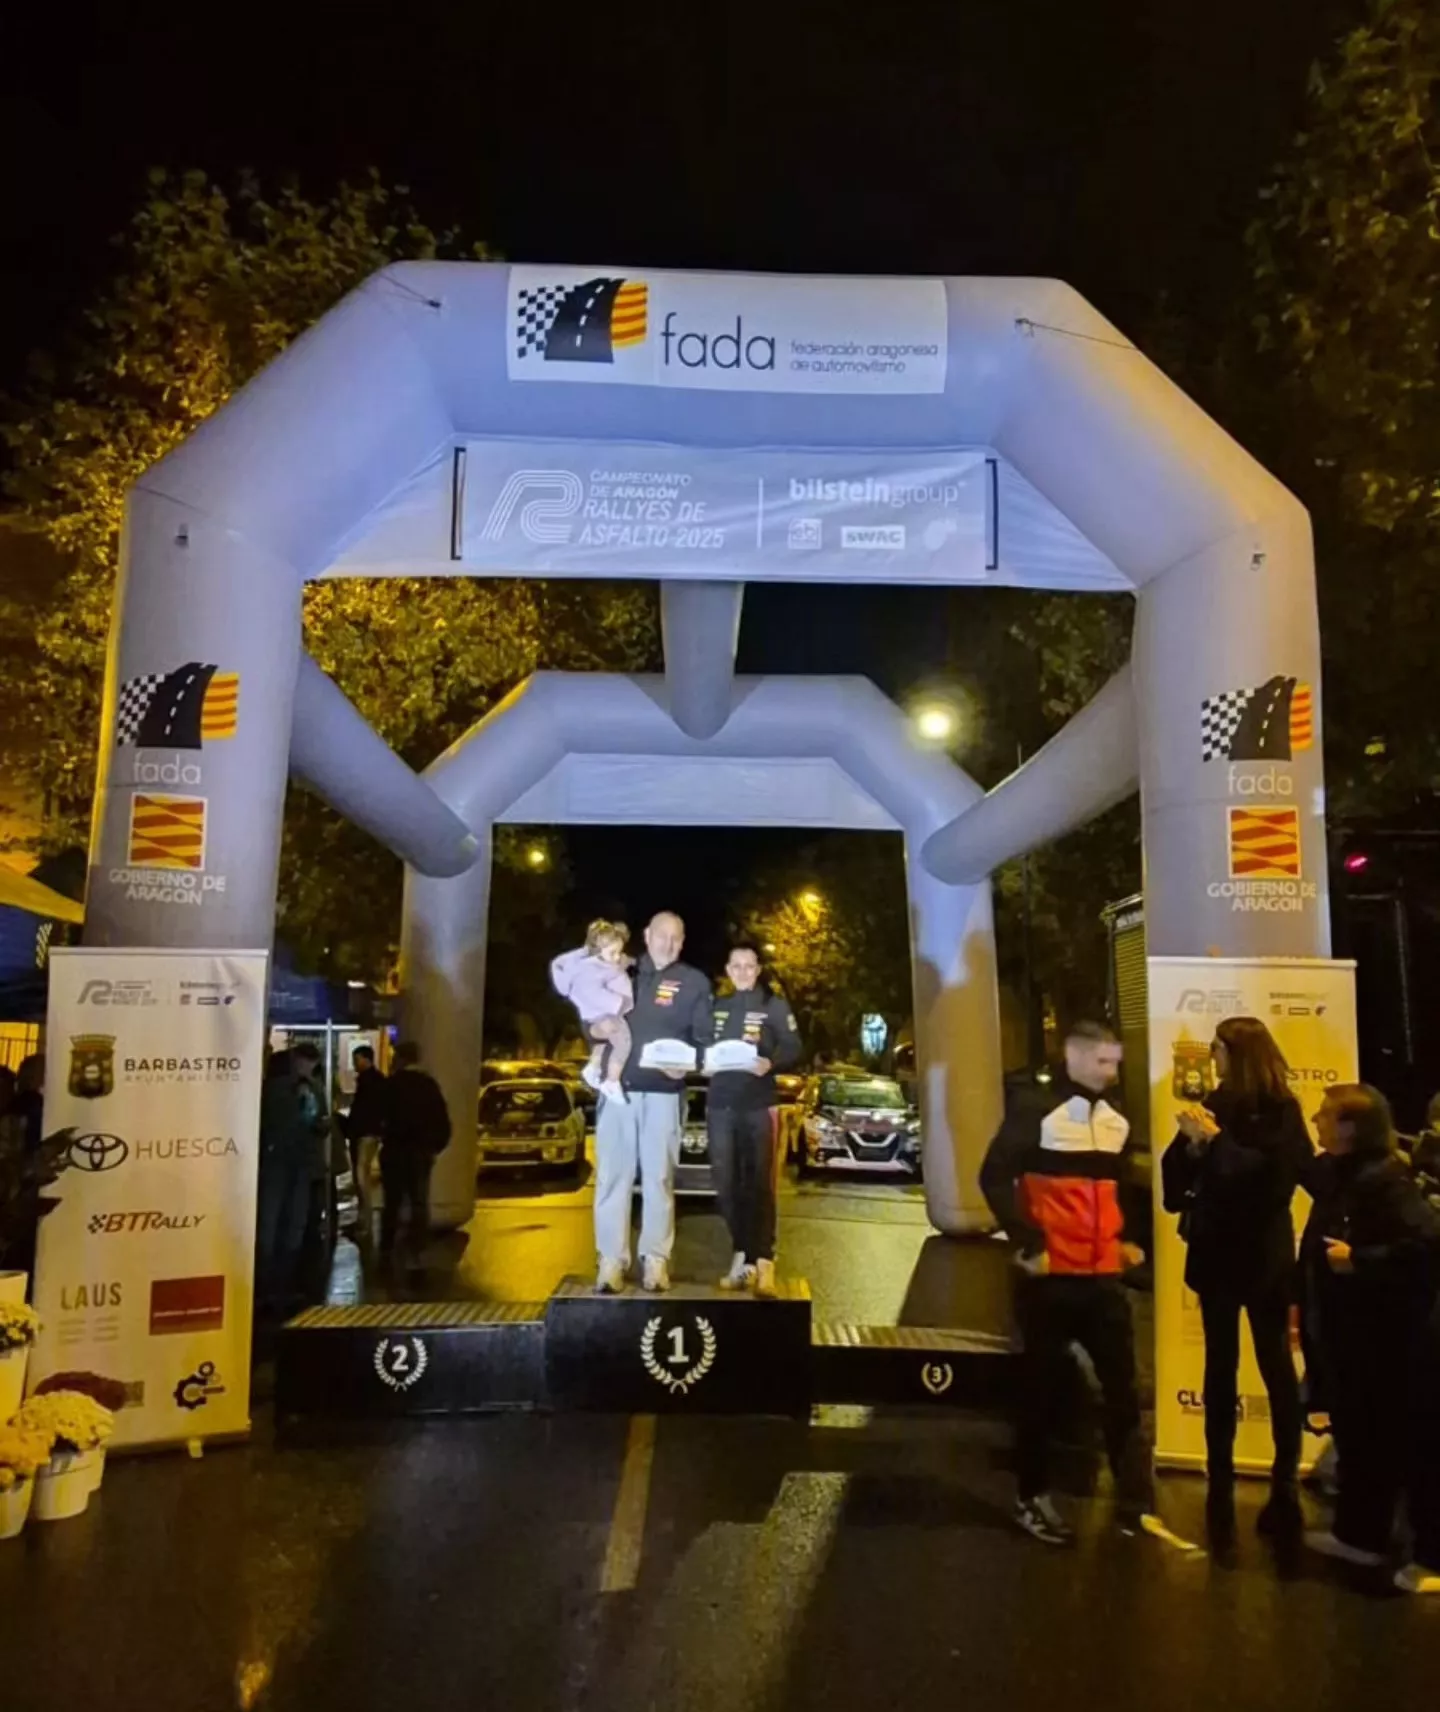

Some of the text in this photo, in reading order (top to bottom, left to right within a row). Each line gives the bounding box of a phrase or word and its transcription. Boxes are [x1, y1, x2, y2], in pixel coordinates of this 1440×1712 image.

[660, 312, 777, 371] fada
[791, 339, 939, 360] federación aragonesa
[790, 359, 906, 373] de automovilismo
[590, 470, 692, 487] CAMPEONATO
[590, 485, 611, 497] DE
[582, 499, 707, 523] RALLYES DE
[578, 523, 727, 549] ASFALTO 2025
[133, 752, 202, 785] fada
[1227, 765, 1293, 796] fada
[109, 868, 227, 893] GOBIERNO DE
[1207, 880, 1316, 898] GOBIERNO DE
[124, 1057, 241, 1072] BARBASTRO
[136, 1137, 239, 1160] HUESCA
[60, 1282, 122, 1311] LAUS
[667, 1326, 690, 1364] 1
[391, 1344, 409, 1371] 2
[931, 1365, 942, 1383] 3
